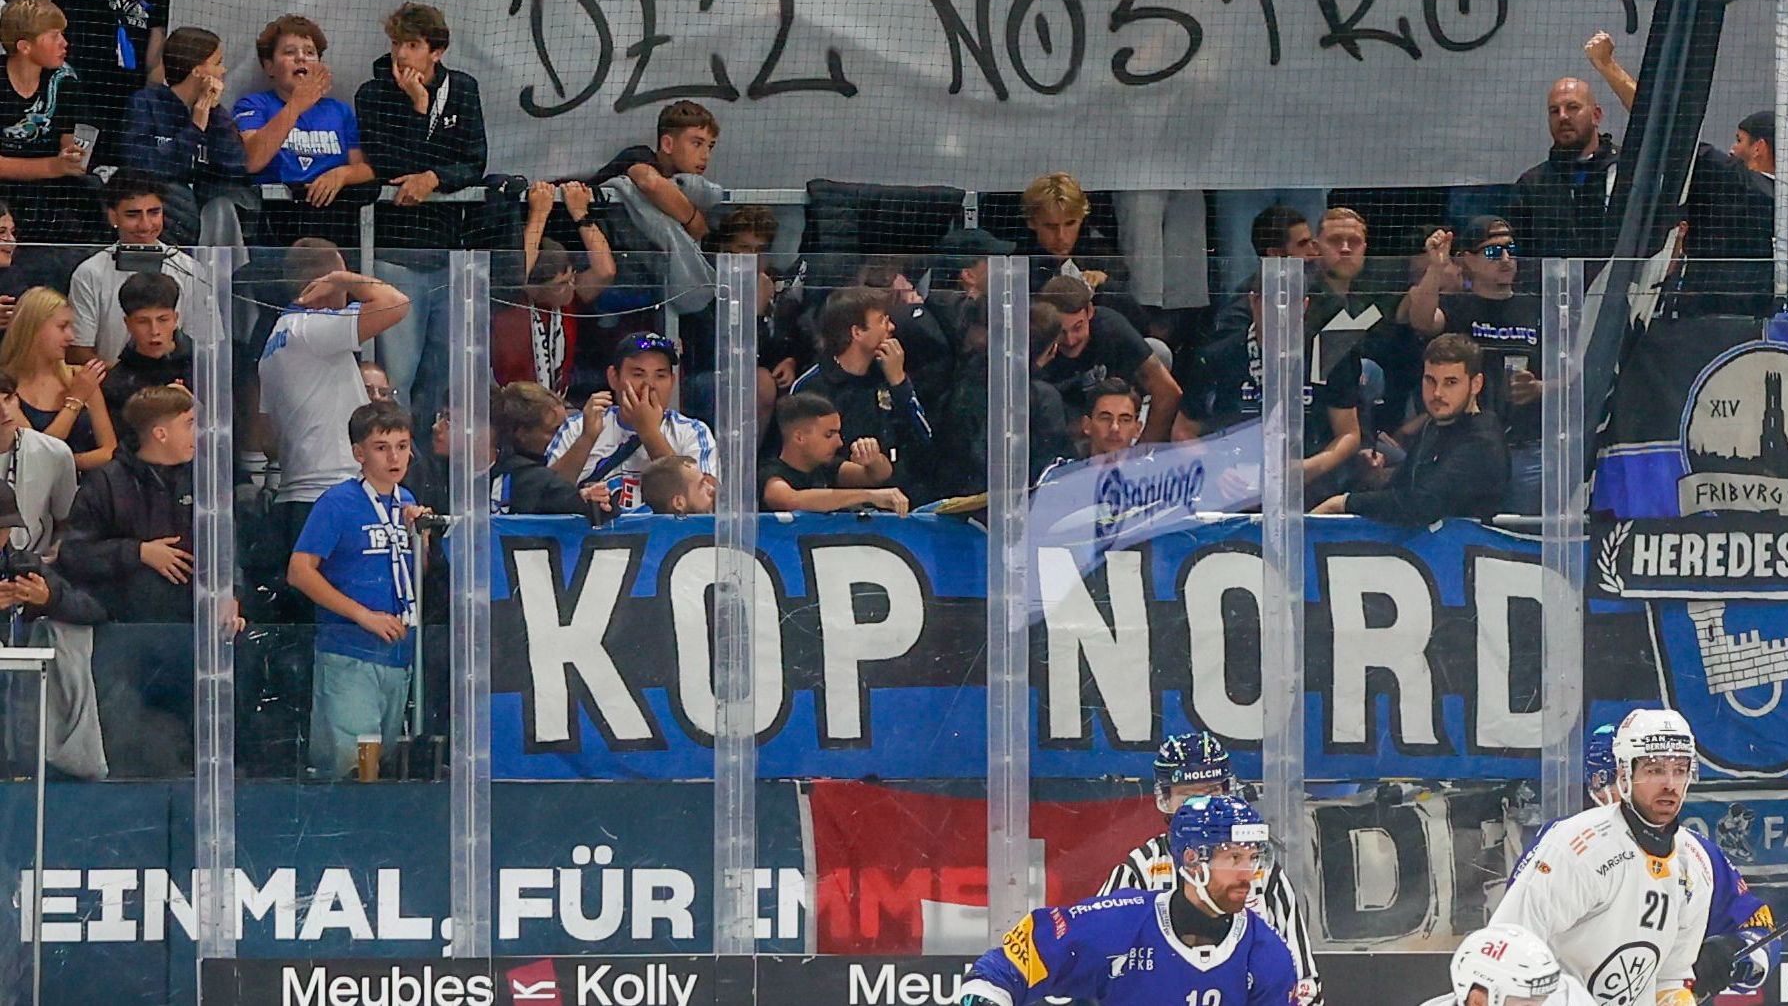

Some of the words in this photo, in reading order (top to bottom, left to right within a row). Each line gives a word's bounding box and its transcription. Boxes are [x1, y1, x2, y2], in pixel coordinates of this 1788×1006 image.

[1710, 399, 1740, 418] XIV
[513, 545, 926, 743] KOP
[1036, 546, 1586, 750] NORD
[1645, 735, 1665, 743] SAN
[1184, 769, 1222, 781] HOLCIM
[19, 867, 452, 958] EINMAL,
[499, 844, 696, 941] FÜR
[1640, 890, 1670, 931] 21
[1129, 948, 1154, 959] BCF
[1480, 941, 1509, 961] ail
[1129, 959, 1154, 971] FKB
[282, 965, 495, 1006] Meubles
[576, 962, 698, 1006] Kolly
